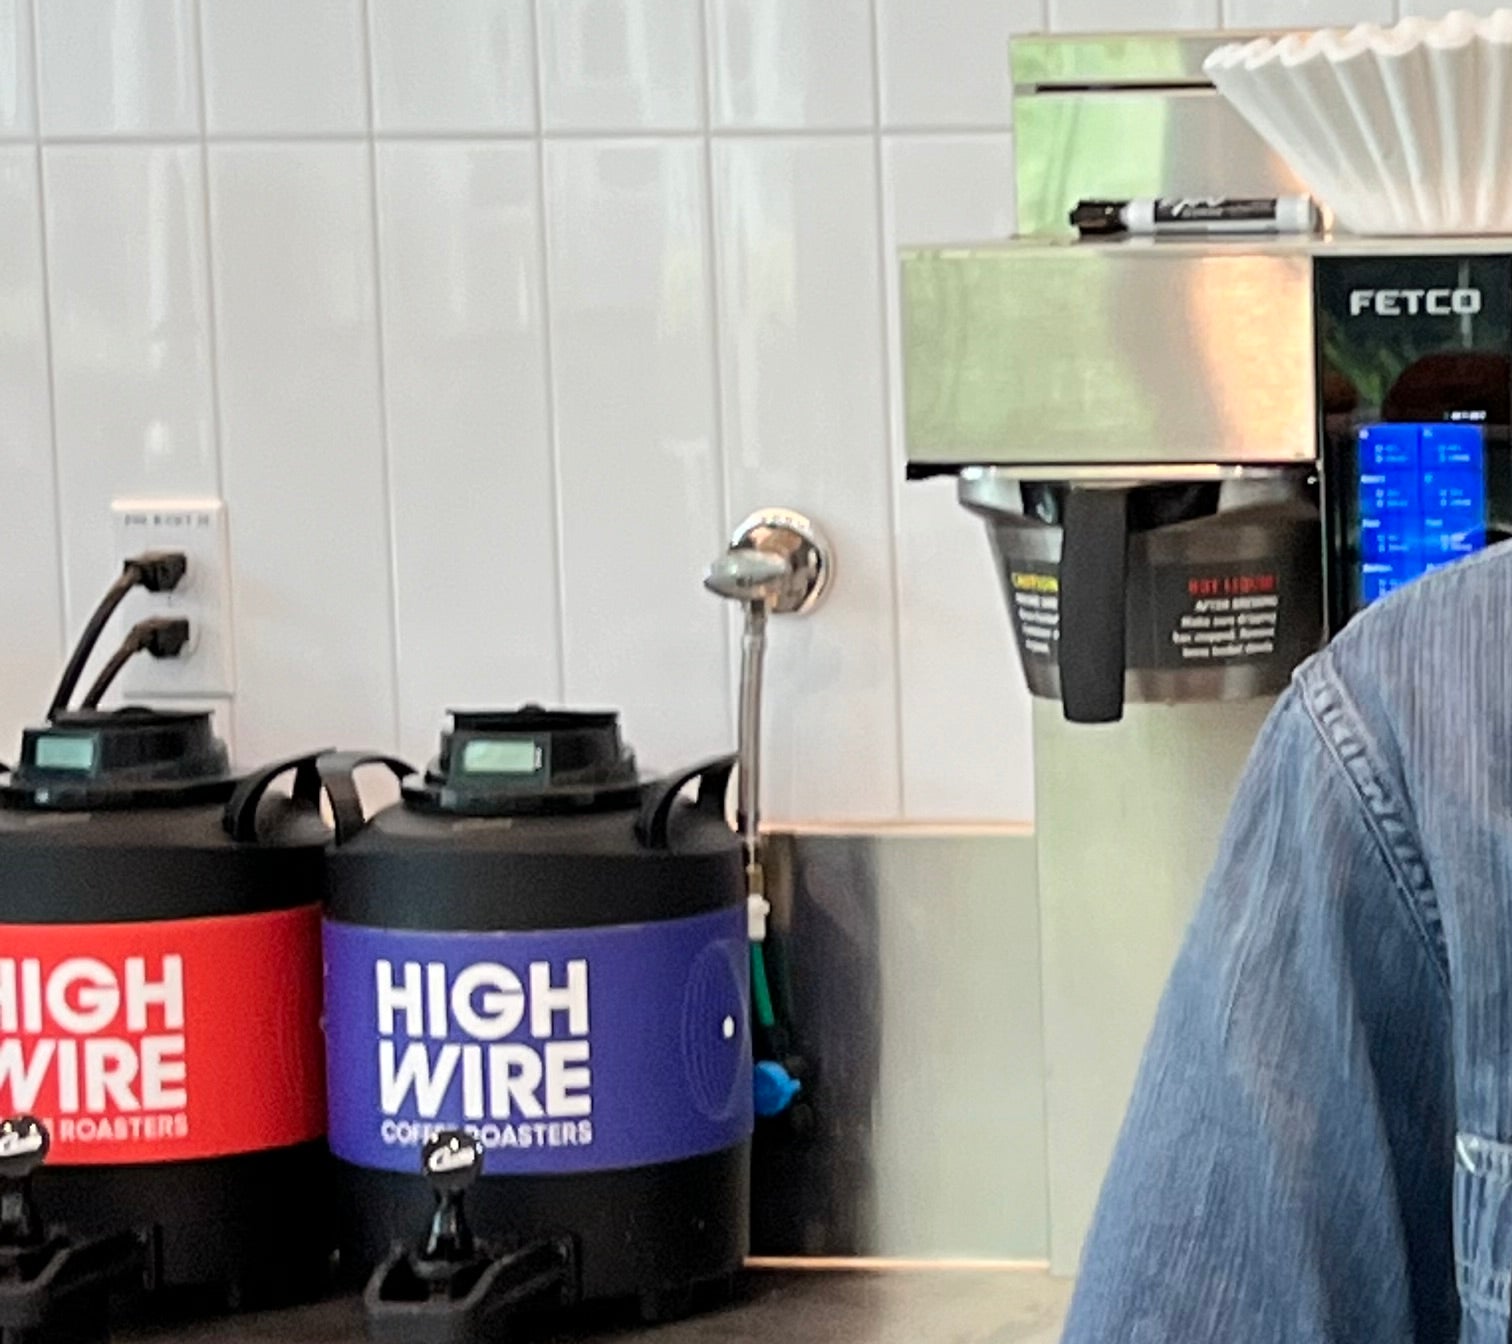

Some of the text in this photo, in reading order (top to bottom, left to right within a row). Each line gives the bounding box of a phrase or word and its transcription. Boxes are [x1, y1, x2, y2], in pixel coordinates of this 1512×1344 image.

[1349, 288, 1482, 316] FETCO
[376, 959, 589, 1041] HIGH
[379, 1040, 592, 1120] WIRE
[59, 1113, 189, 1144] ROASTERS
